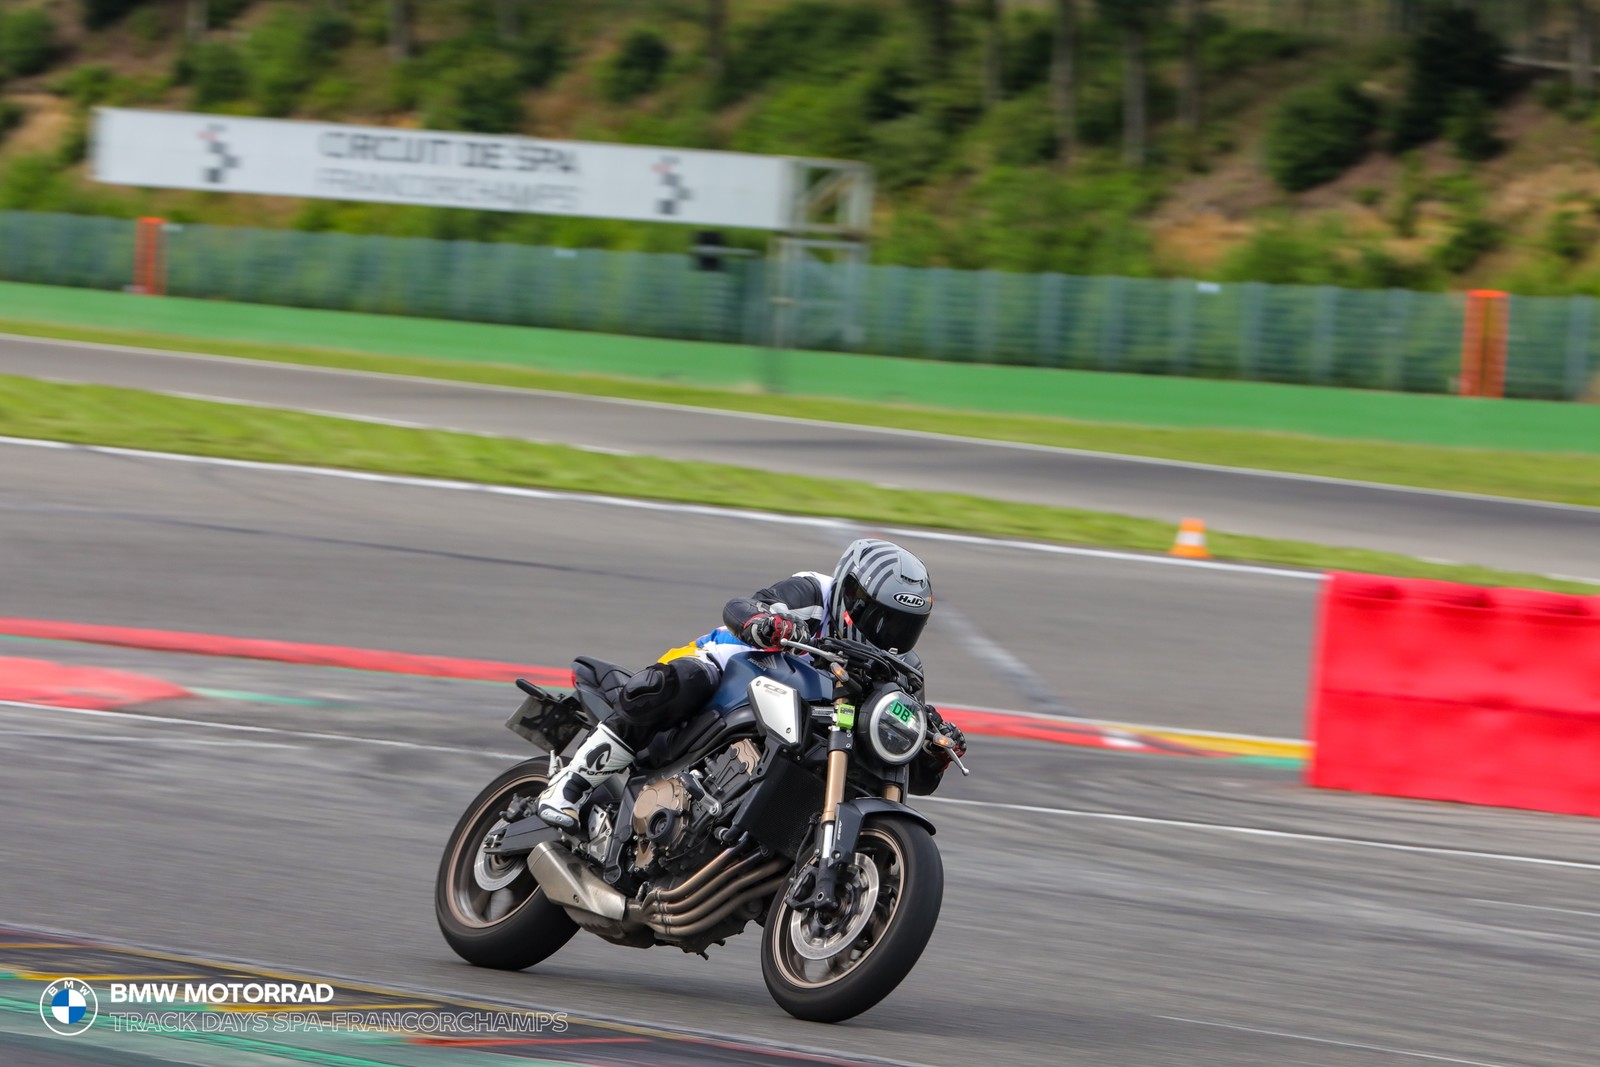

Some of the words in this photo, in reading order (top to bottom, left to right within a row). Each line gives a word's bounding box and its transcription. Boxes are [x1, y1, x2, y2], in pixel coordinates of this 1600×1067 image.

[317, 131, 452, 165] CIRCUIT
[461, 141, 507, 170] DE
[513, 145, 580, 174] SPA
[898, 593, 924, 607] HJC
[892, 702, 911, 723] DB
